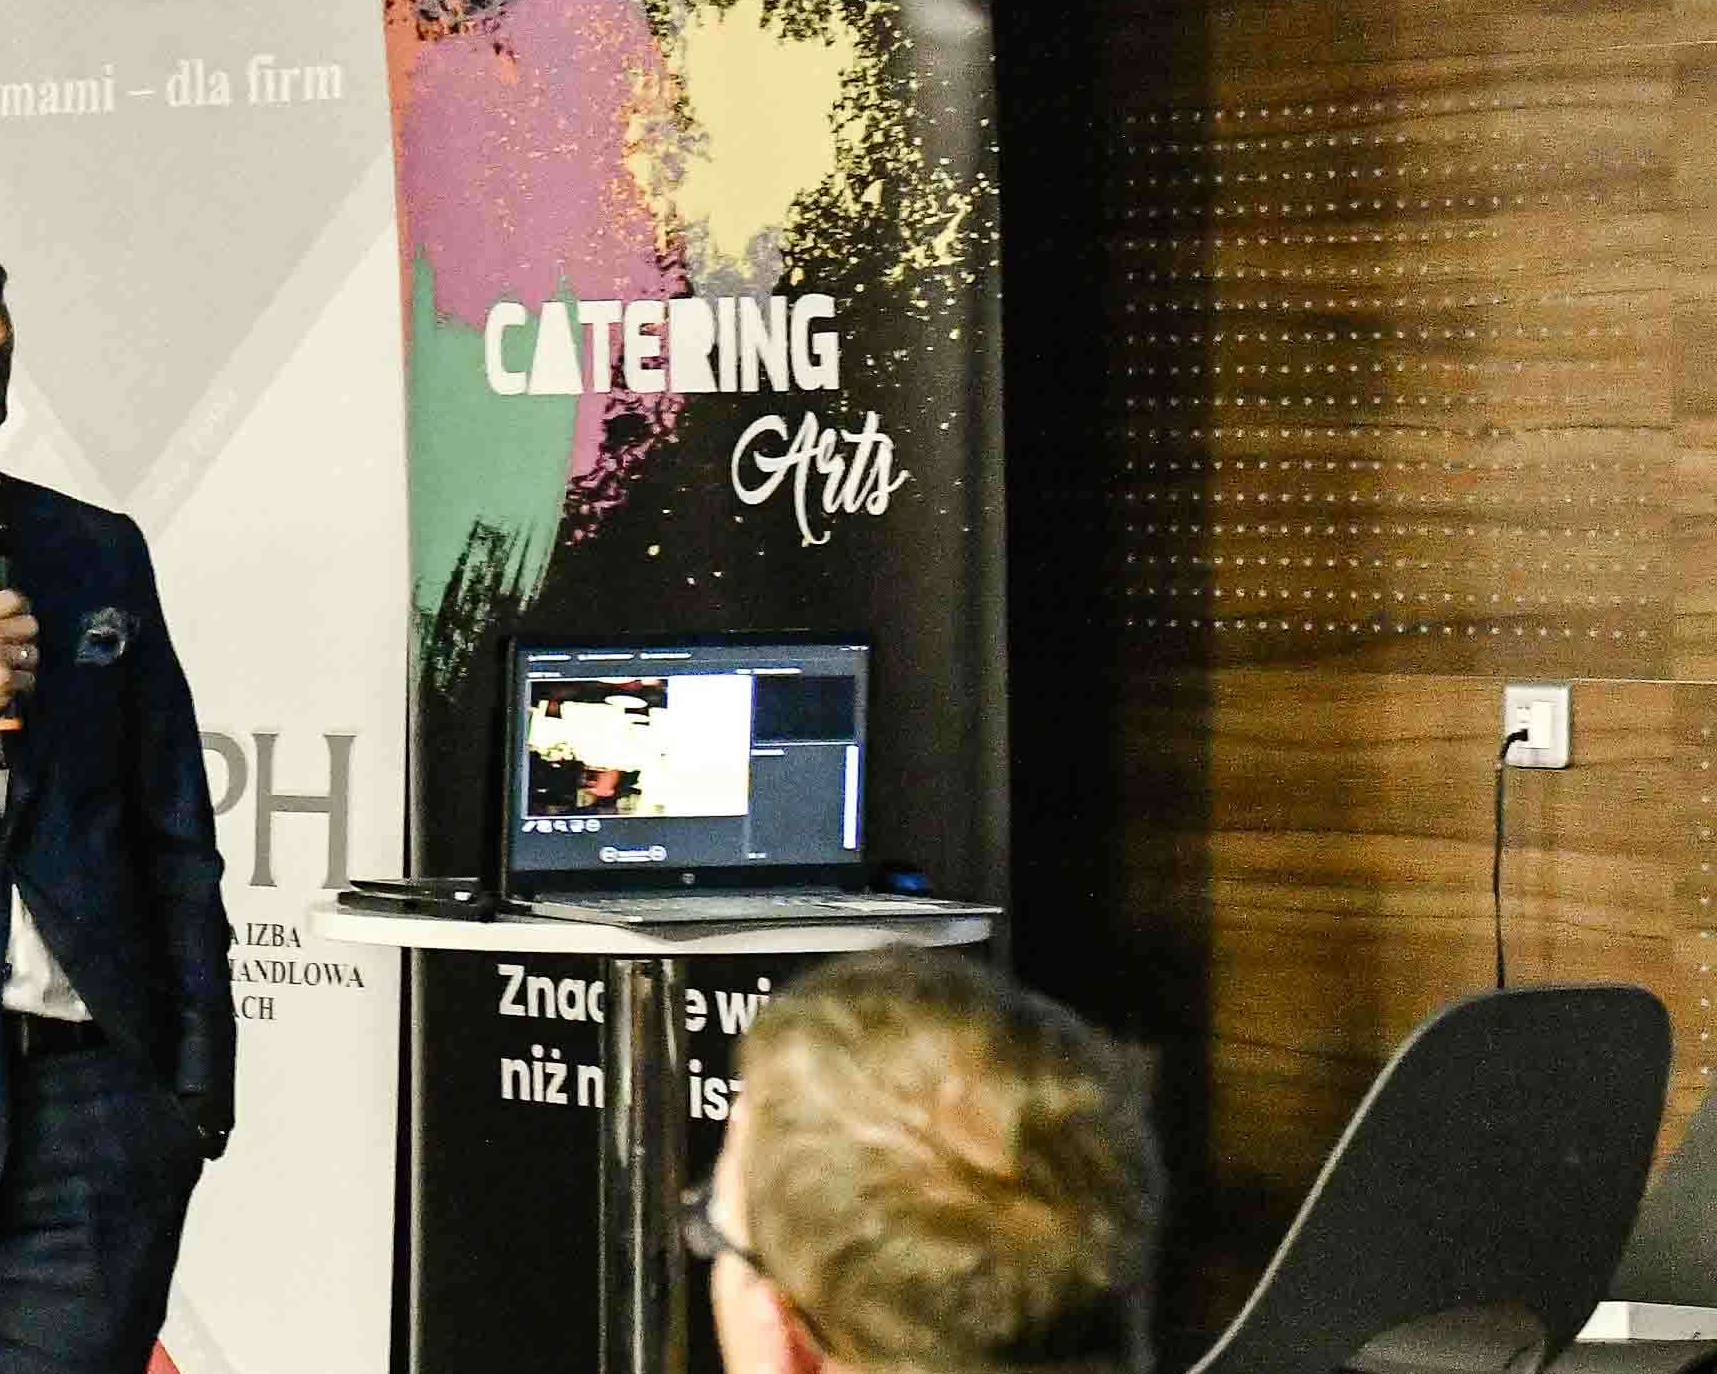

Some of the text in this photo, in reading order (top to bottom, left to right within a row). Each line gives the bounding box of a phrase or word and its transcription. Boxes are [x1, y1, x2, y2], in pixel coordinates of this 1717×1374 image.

[166, 59, 231, 108] dla
[246, 54, 343, 107] firm
[484, 293, 841, 396] CATERING
[730, 410, 910, 545] Arts
[245, 922, 302, 948] IZBA
[500, 1044, 569, 1105] niż
